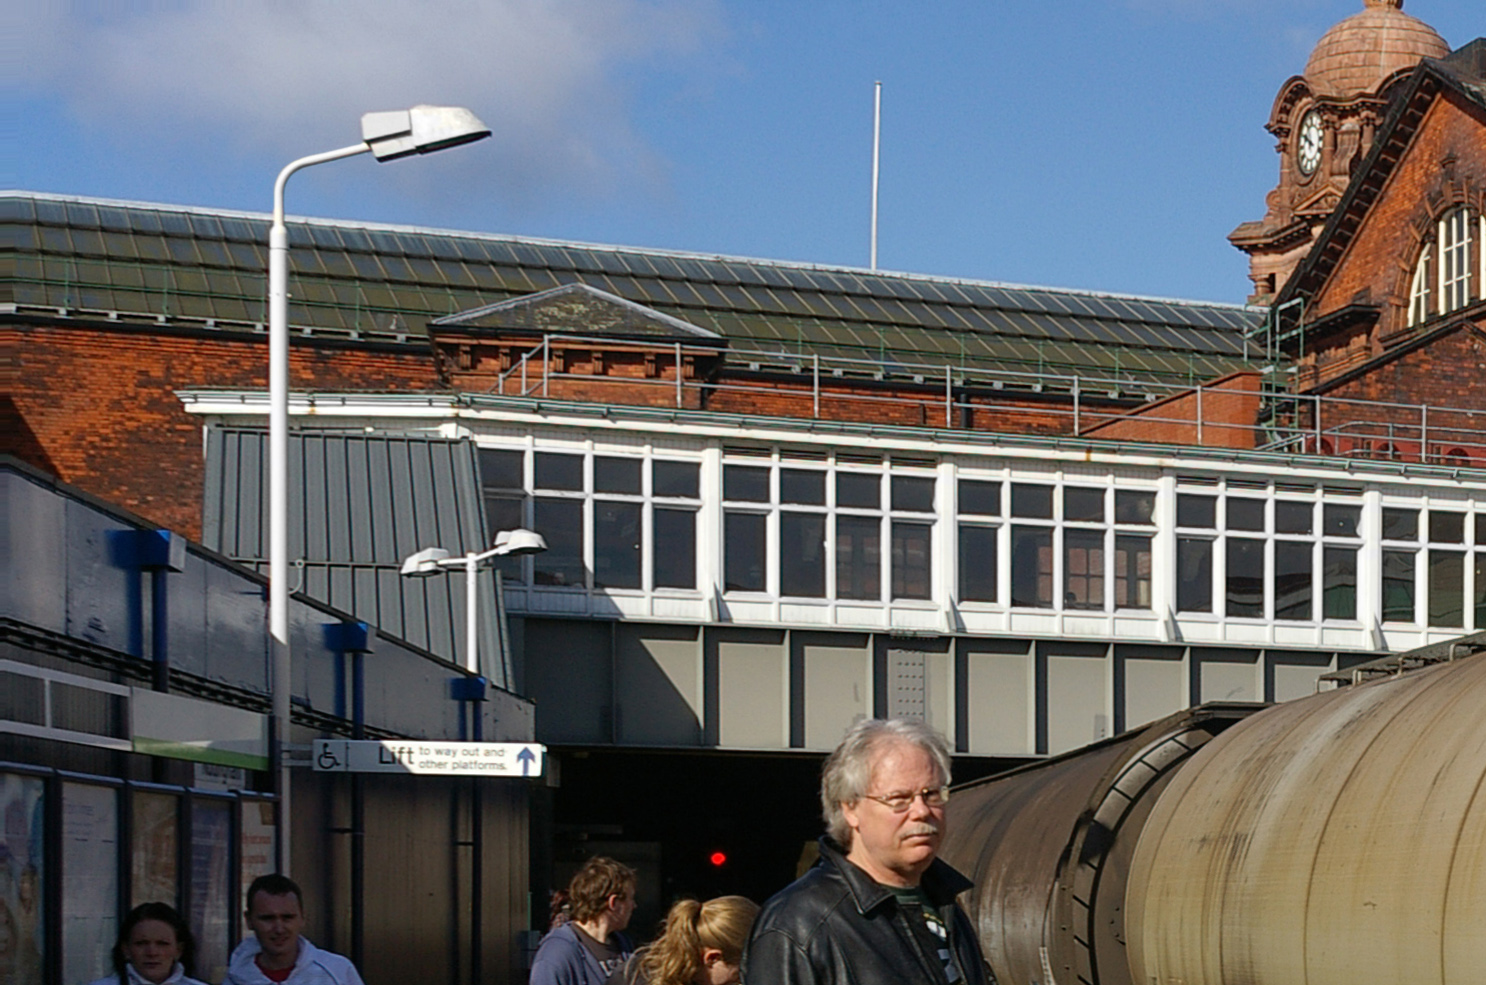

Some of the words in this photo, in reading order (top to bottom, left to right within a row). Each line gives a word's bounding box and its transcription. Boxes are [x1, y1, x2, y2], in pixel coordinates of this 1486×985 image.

[378, 746, 414, 765] Lift
[419, 746, 431, 756] to
[435, 748, 458, 758] way
[461, 747, 480, 757] out
[483, 748, 505, 758] and
[419, 759, 448, 769] other
